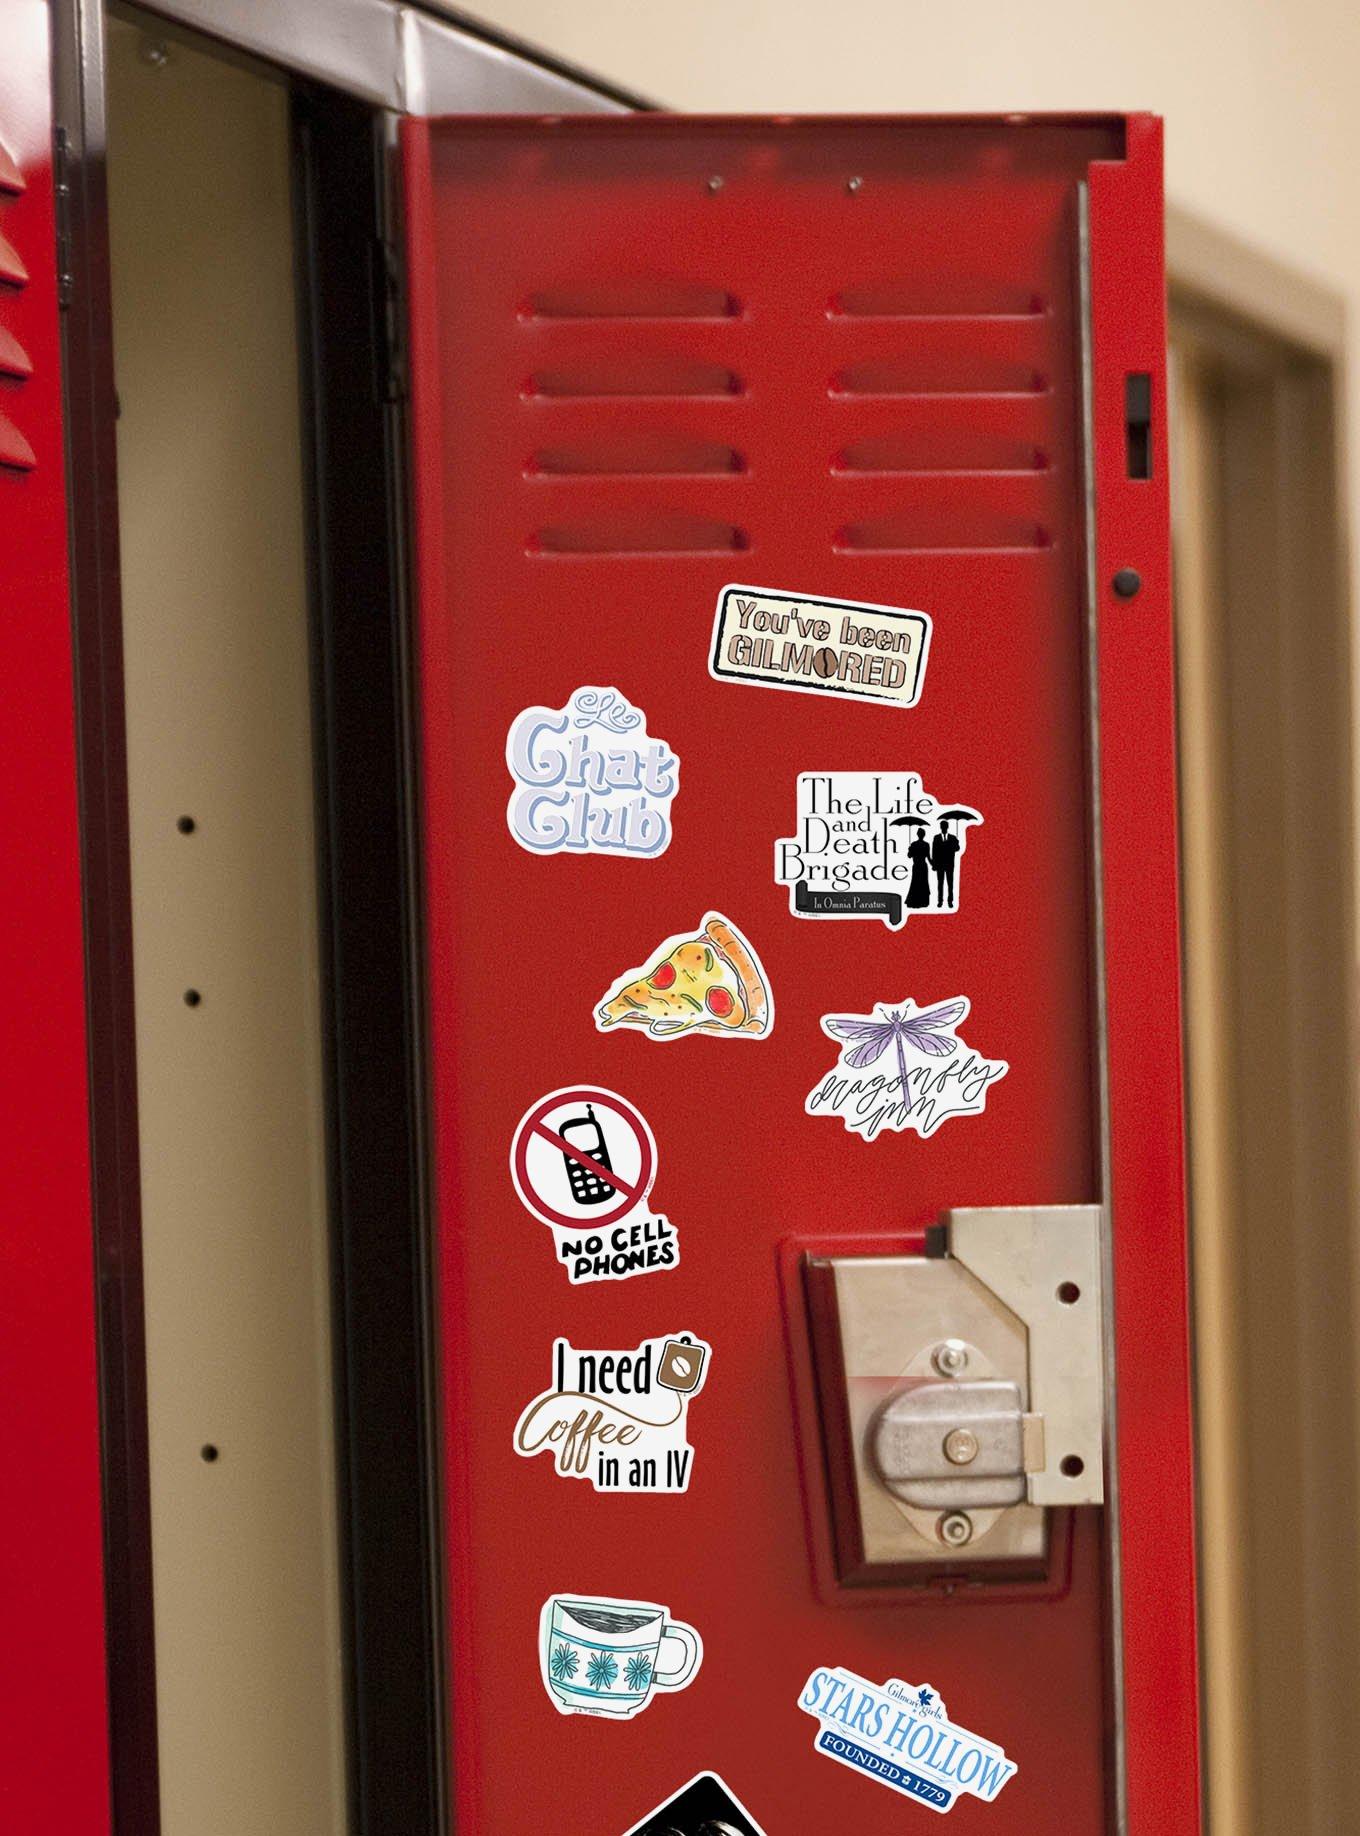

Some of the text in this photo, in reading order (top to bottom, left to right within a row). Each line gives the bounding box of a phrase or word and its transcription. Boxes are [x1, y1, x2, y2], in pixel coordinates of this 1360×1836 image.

[736, 600, 911, 654] You've been
[574, 691, 641, 734] Le
[512, 713, 675, 798] Chat
[803, 777, 933, 814] The Life
[832, 806, 871, 832] and
[514, 788, 667, 853] Club
[803, 817, 899, 854] Death
[779, 844, 908, 891] Brigade
[814, 896, 887, 908] In Omnia Paratus
[811, 1055, 1003, 1114] dragonfly
[562, 1219, 672, 1257] NO CELL
[574, 1241, 674, 1279] PHONES
[557, 1343, 651, 1394] I need
[518, 1391, 643, 1473] Coffee
[599, 1450, 689, 1487] in an IV
[803, 1672, 1012, 1797] STARS HOLLOW
[823, 1735, 946, 1803] FOUNDED 1779
